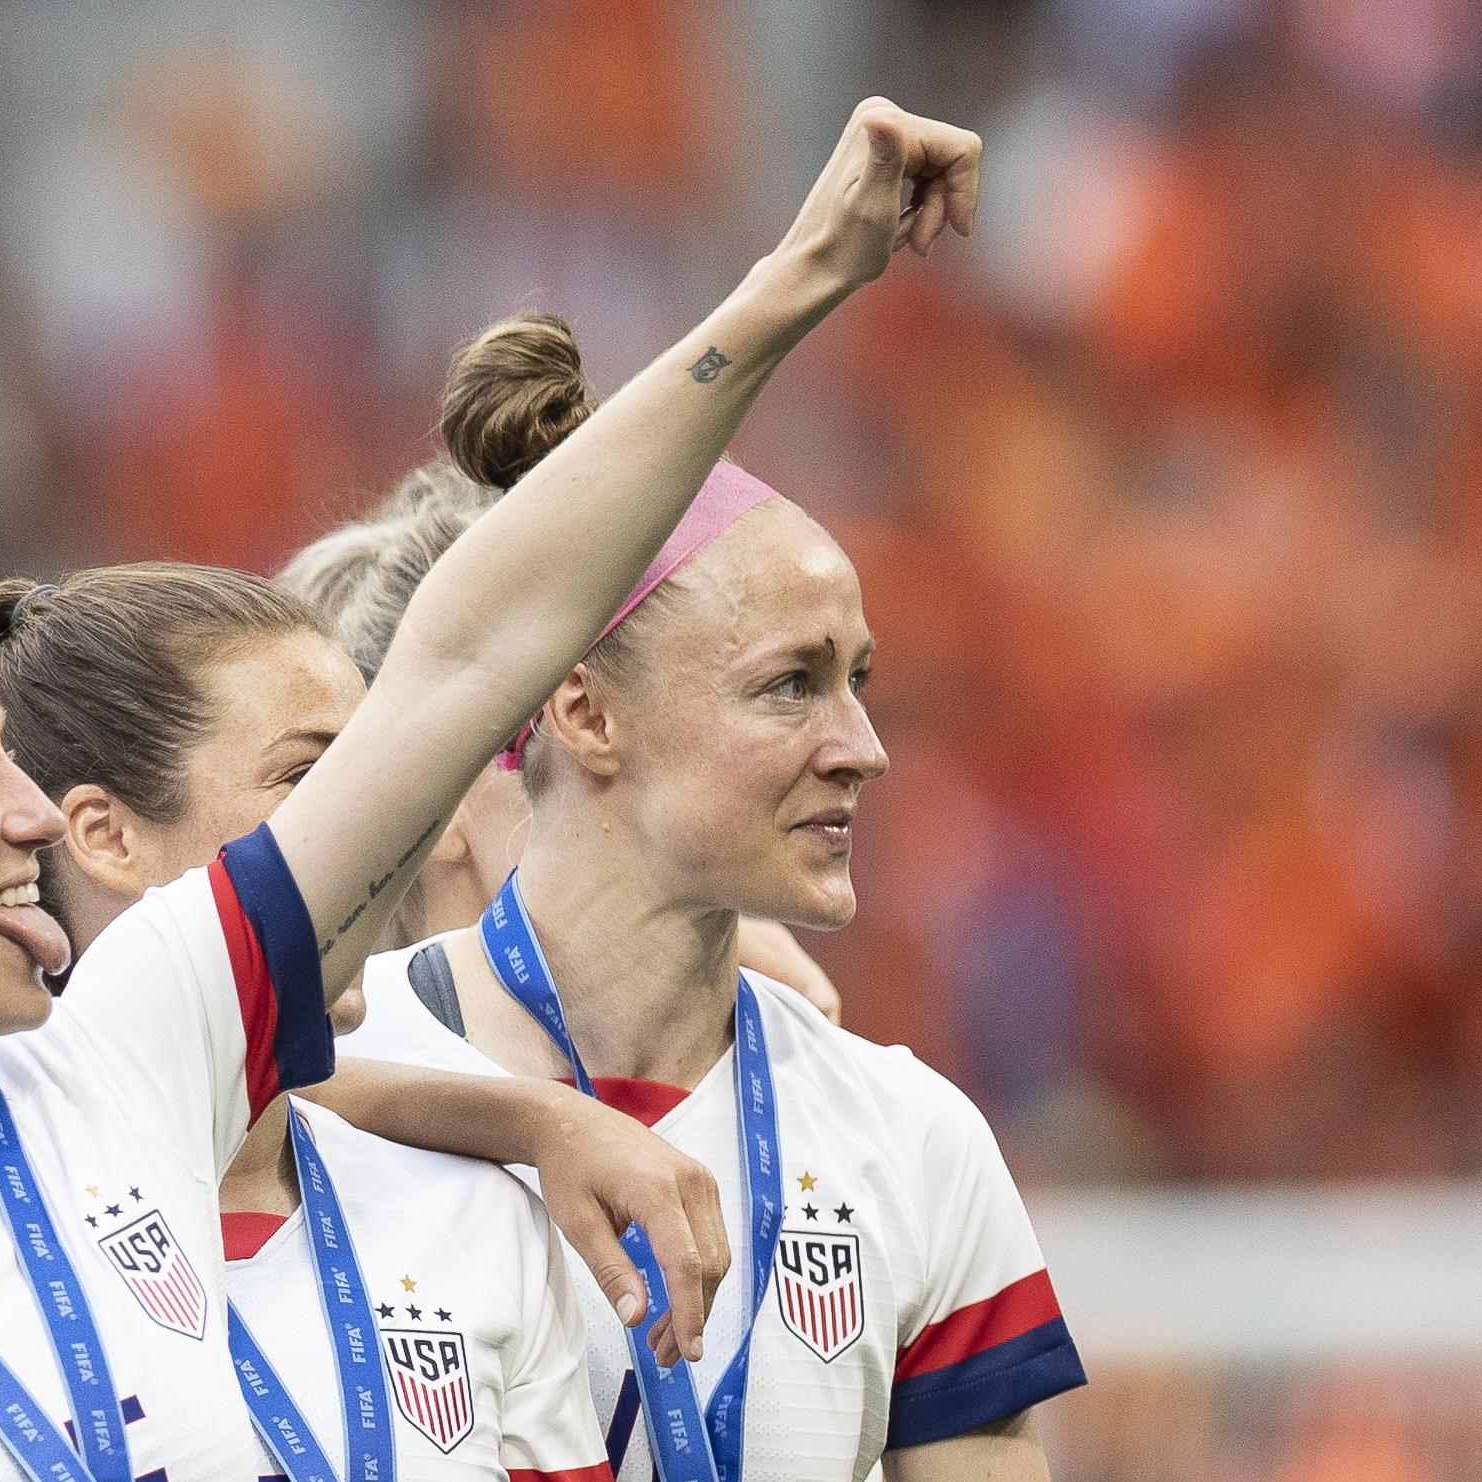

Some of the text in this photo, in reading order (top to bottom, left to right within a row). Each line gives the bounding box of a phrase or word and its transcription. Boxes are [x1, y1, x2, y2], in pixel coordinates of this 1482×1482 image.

[109, 1222, 170, 1274] USA
[780, 1241, 853, 1287] USA
[390, 1335, 461, 1382] USA
